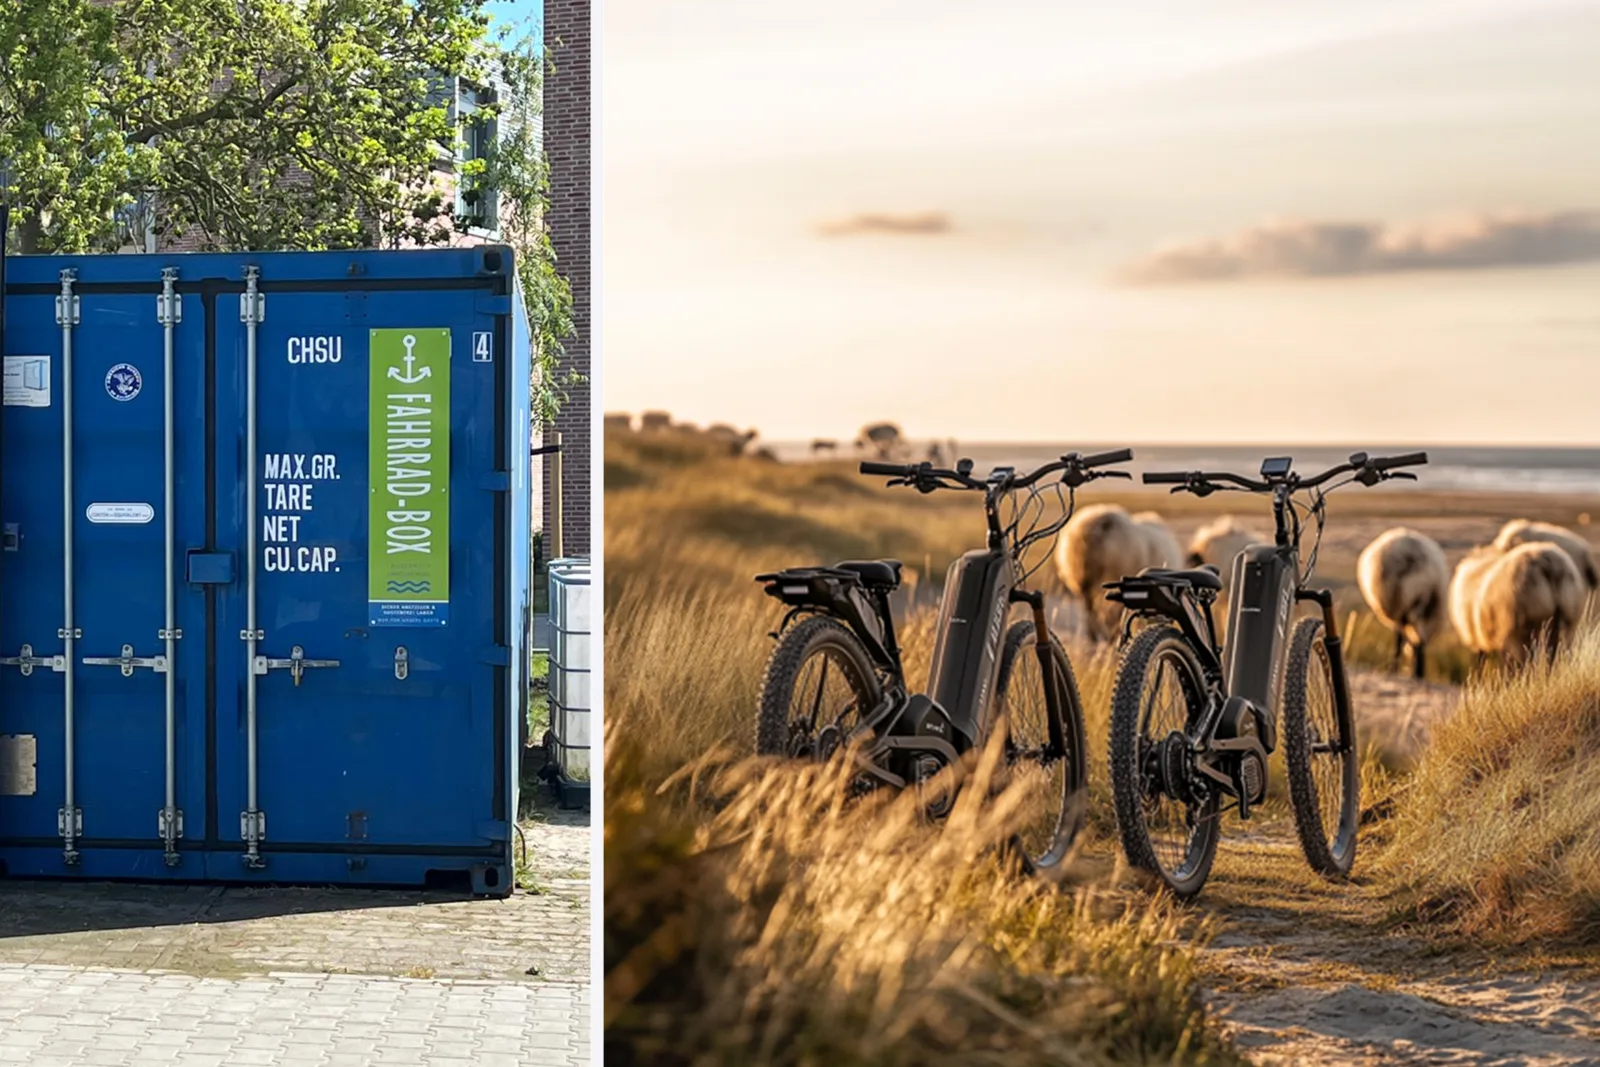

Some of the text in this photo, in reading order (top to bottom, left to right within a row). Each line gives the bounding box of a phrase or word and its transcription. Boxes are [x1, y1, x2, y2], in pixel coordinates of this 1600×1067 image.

[287, 336, 342, 364] CHSU
[476, 334, 488, 360] 4
[264, 453, 341, 480] MAX.GR.
[386, 393, 431, 554] FAHRRAD-BOX
[264, 483, 313, 511] TARE
[263, 515, 301, 542] NET
[264, 546, 341, 572] CU.CAP.
